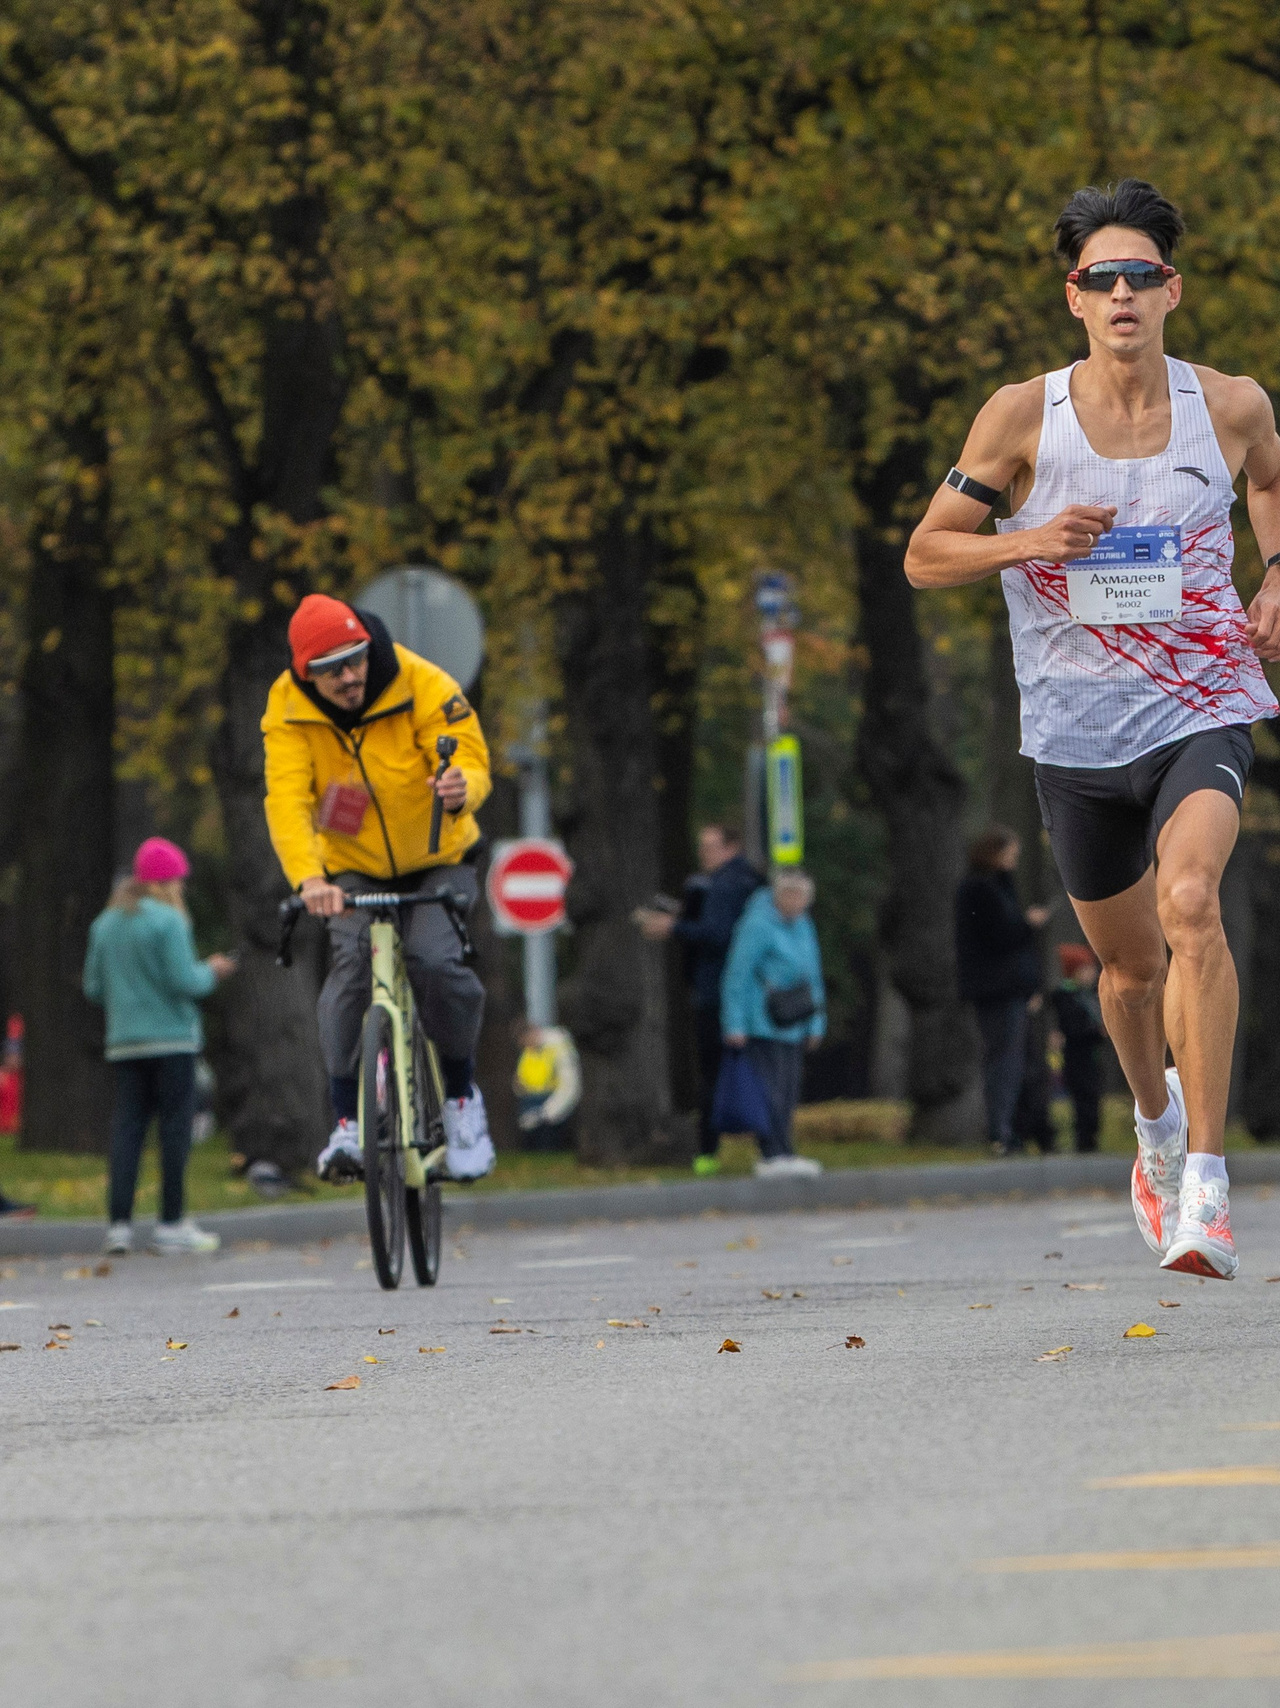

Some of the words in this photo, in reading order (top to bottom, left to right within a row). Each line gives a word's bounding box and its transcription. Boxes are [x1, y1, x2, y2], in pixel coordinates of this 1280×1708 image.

[1090, 552, 1127, 560] СТОЛИЦА
[1090, 573, 1166, 585] Ахмадеев
[1105, 587, 1151, 599] Ринас
[1116, 601, 1142, 609] 16002
